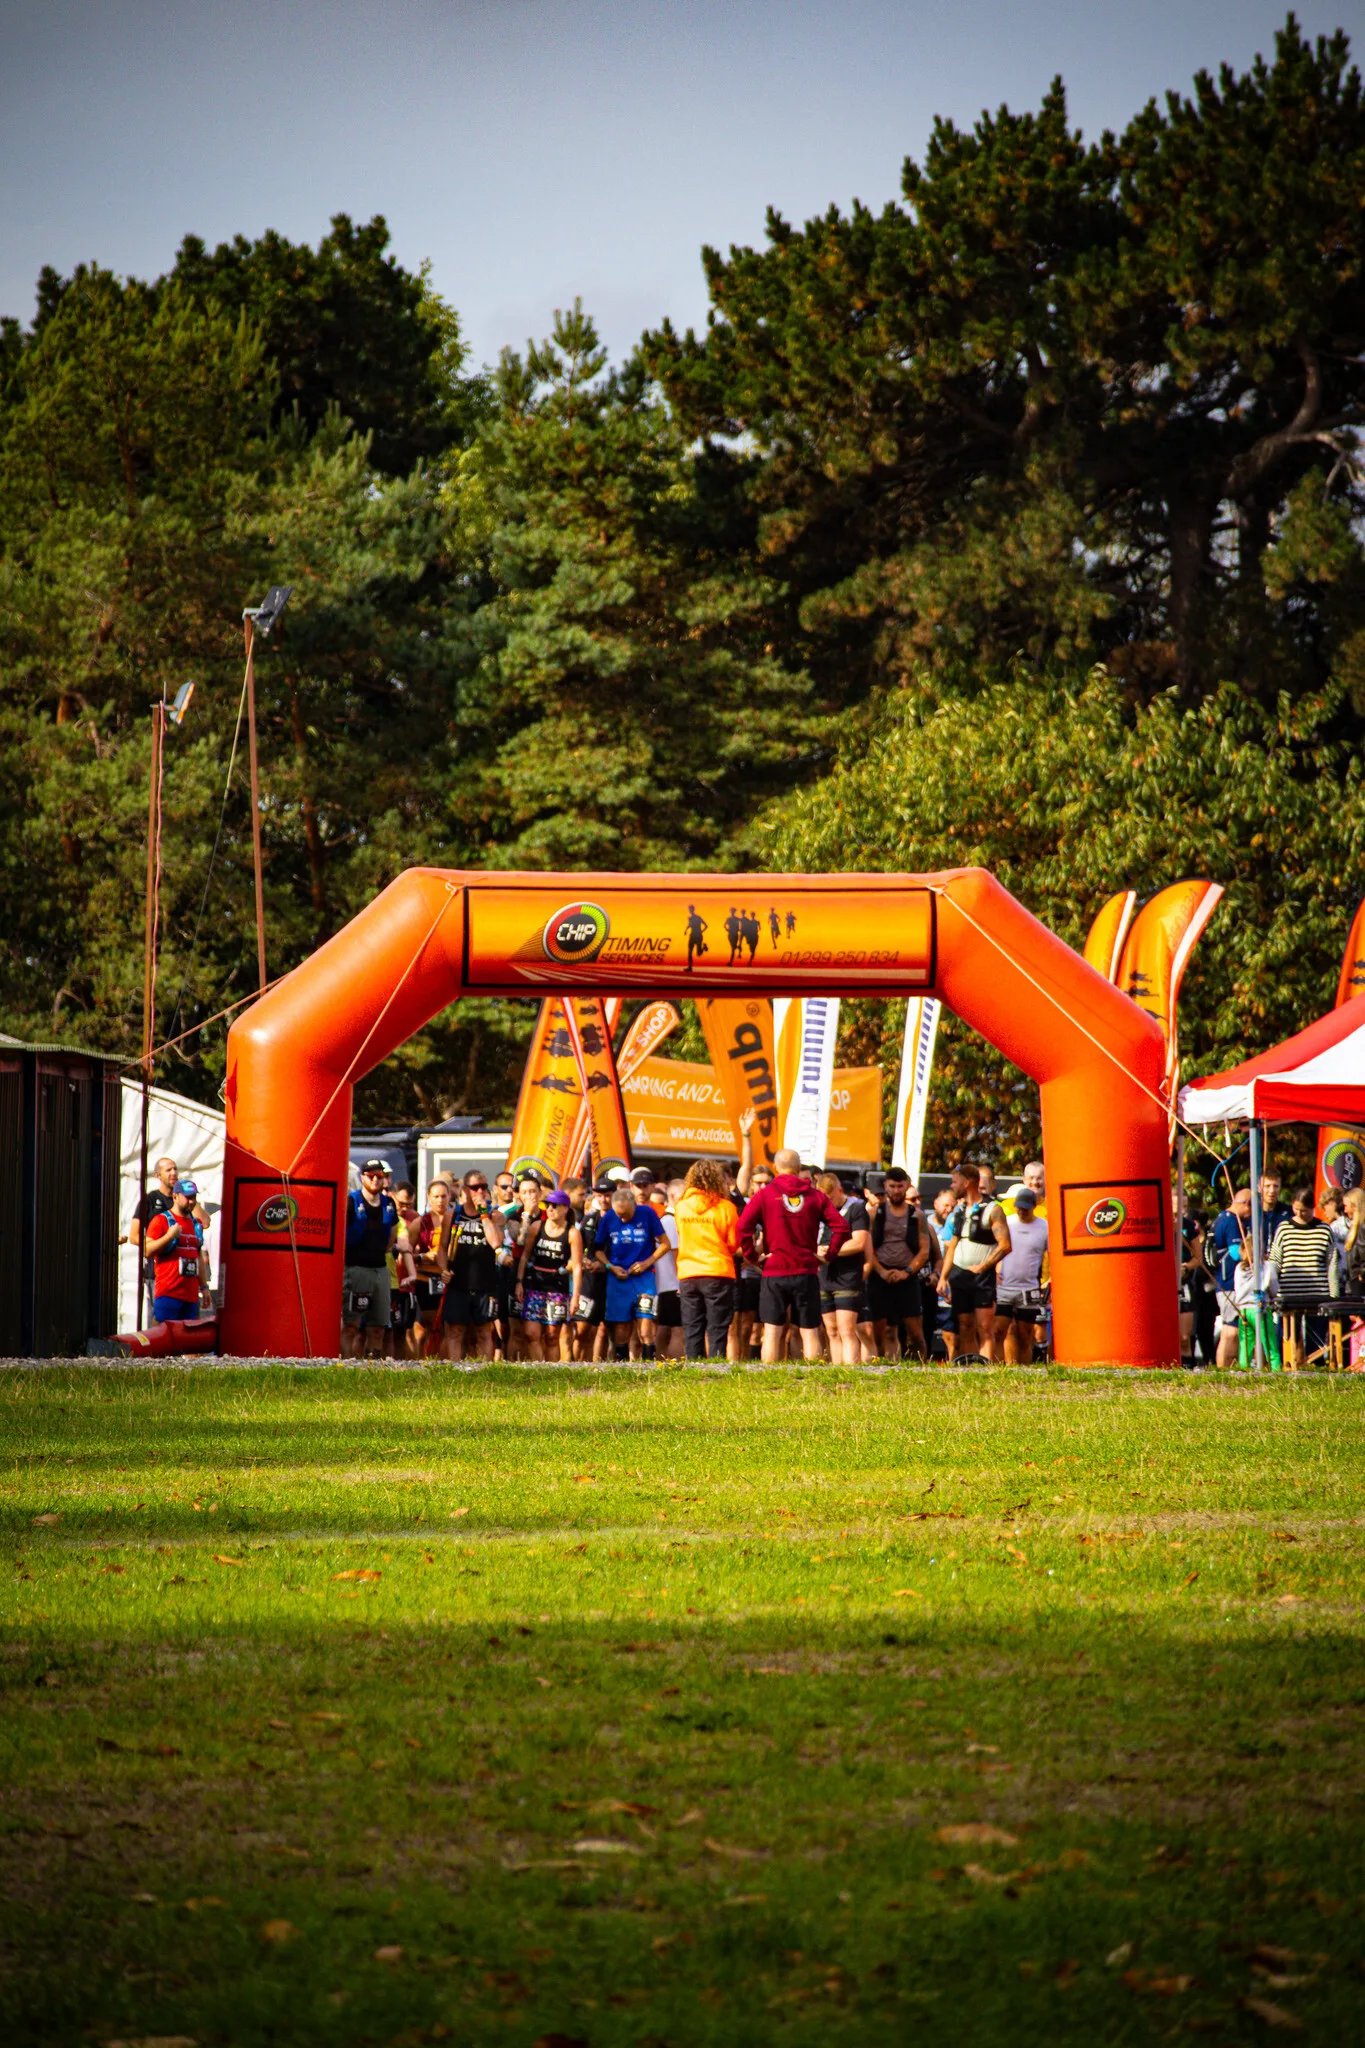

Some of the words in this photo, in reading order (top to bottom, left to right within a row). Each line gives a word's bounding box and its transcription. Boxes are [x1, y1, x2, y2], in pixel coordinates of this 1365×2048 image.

[556, 923, 597, 941] CHIP
[606, 937, 672, 951] TIMING
[600, 952, 666, 964] SERVICES
[780, 951, 833, 966] 01299
[834, 951, 867, 966] 250
[867, 951, 900, 966] 834
[636, 1008, 668, 1048] SHOP
[621, 1075, 678, 1100] AMPING
[677, 1082, 713, 1105] AND
[542, 1106, 565, 1163] TIMING
[670, 1125, 735, 1144] www.outdoo
[1342, 1152, 1356, 1190] CHIP
[265, 1206, 290, 1219] CHIP
[1094, 1210, 1119, 1224] CHIP
